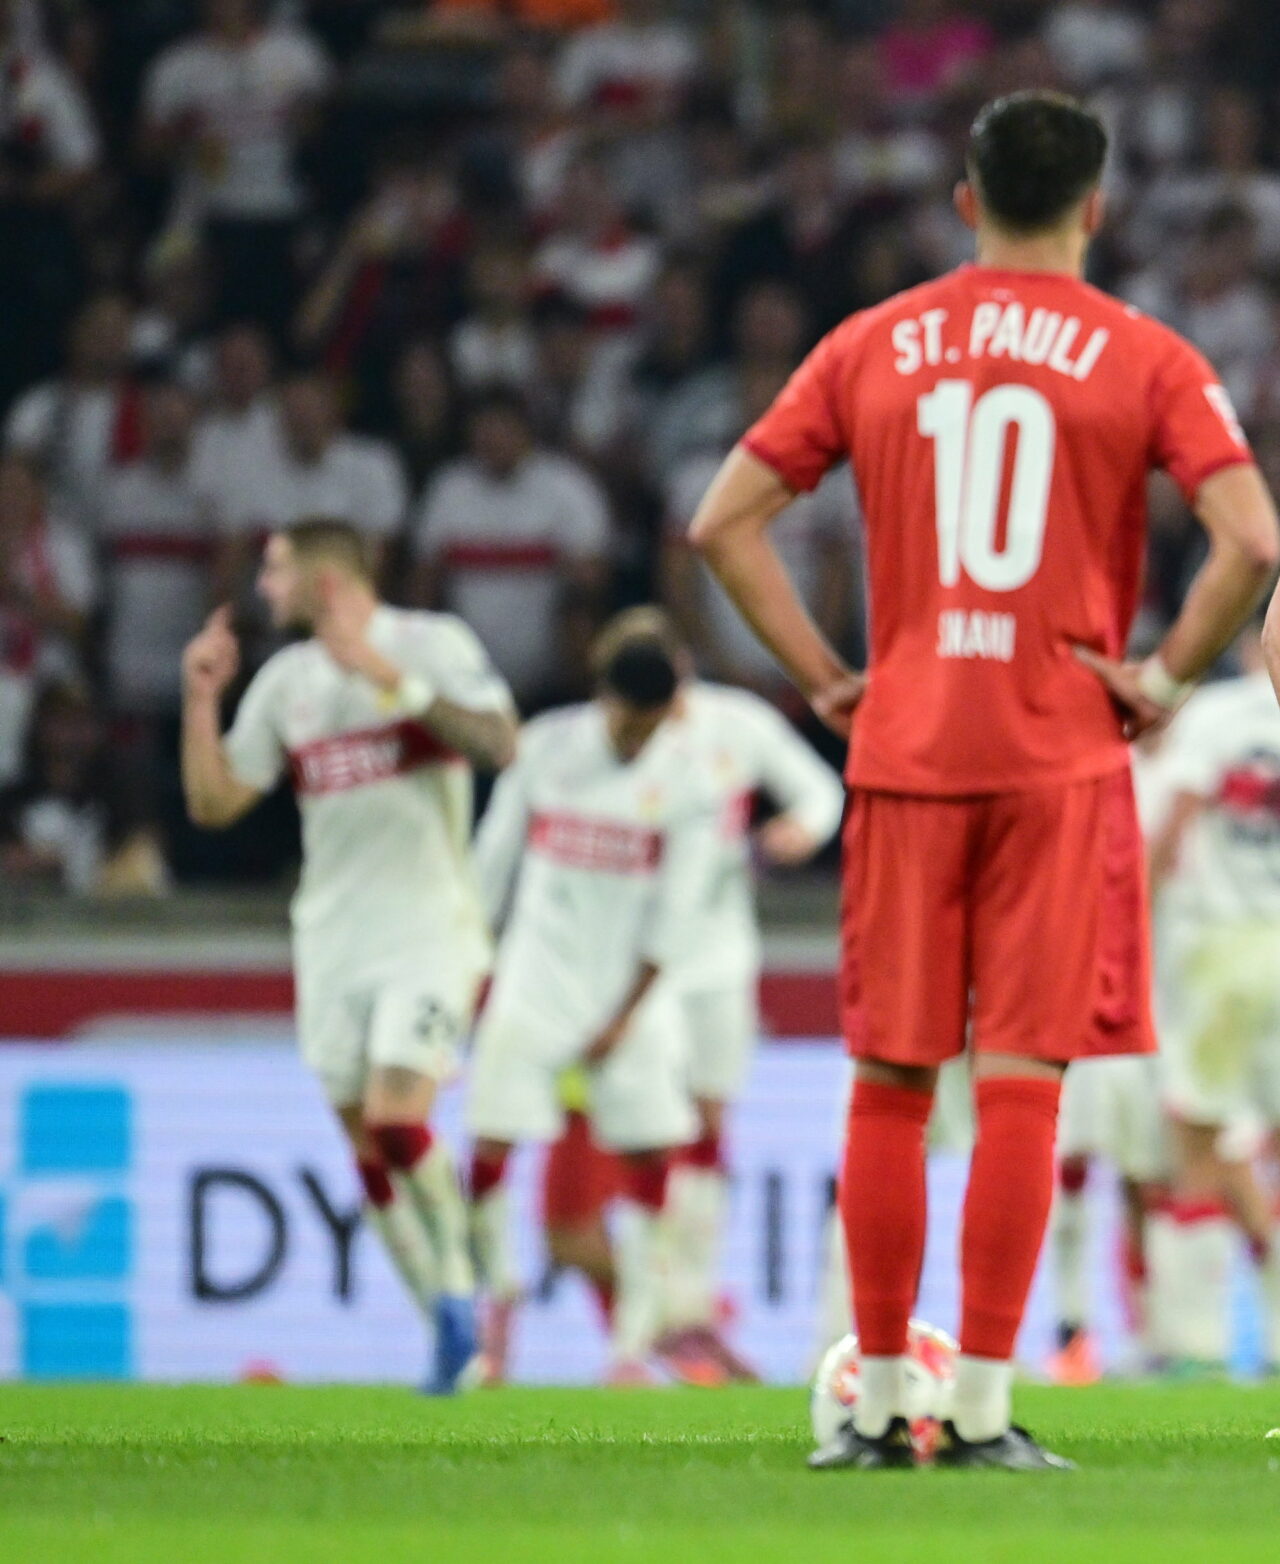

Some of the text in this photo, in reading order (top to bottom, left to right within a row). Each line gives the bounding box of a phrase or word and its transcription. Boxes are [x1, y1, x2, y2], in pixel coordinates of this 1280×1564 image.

[891, 301, 1110, 382] ST. PAULI
[917, 379, 1057, 592] 10
